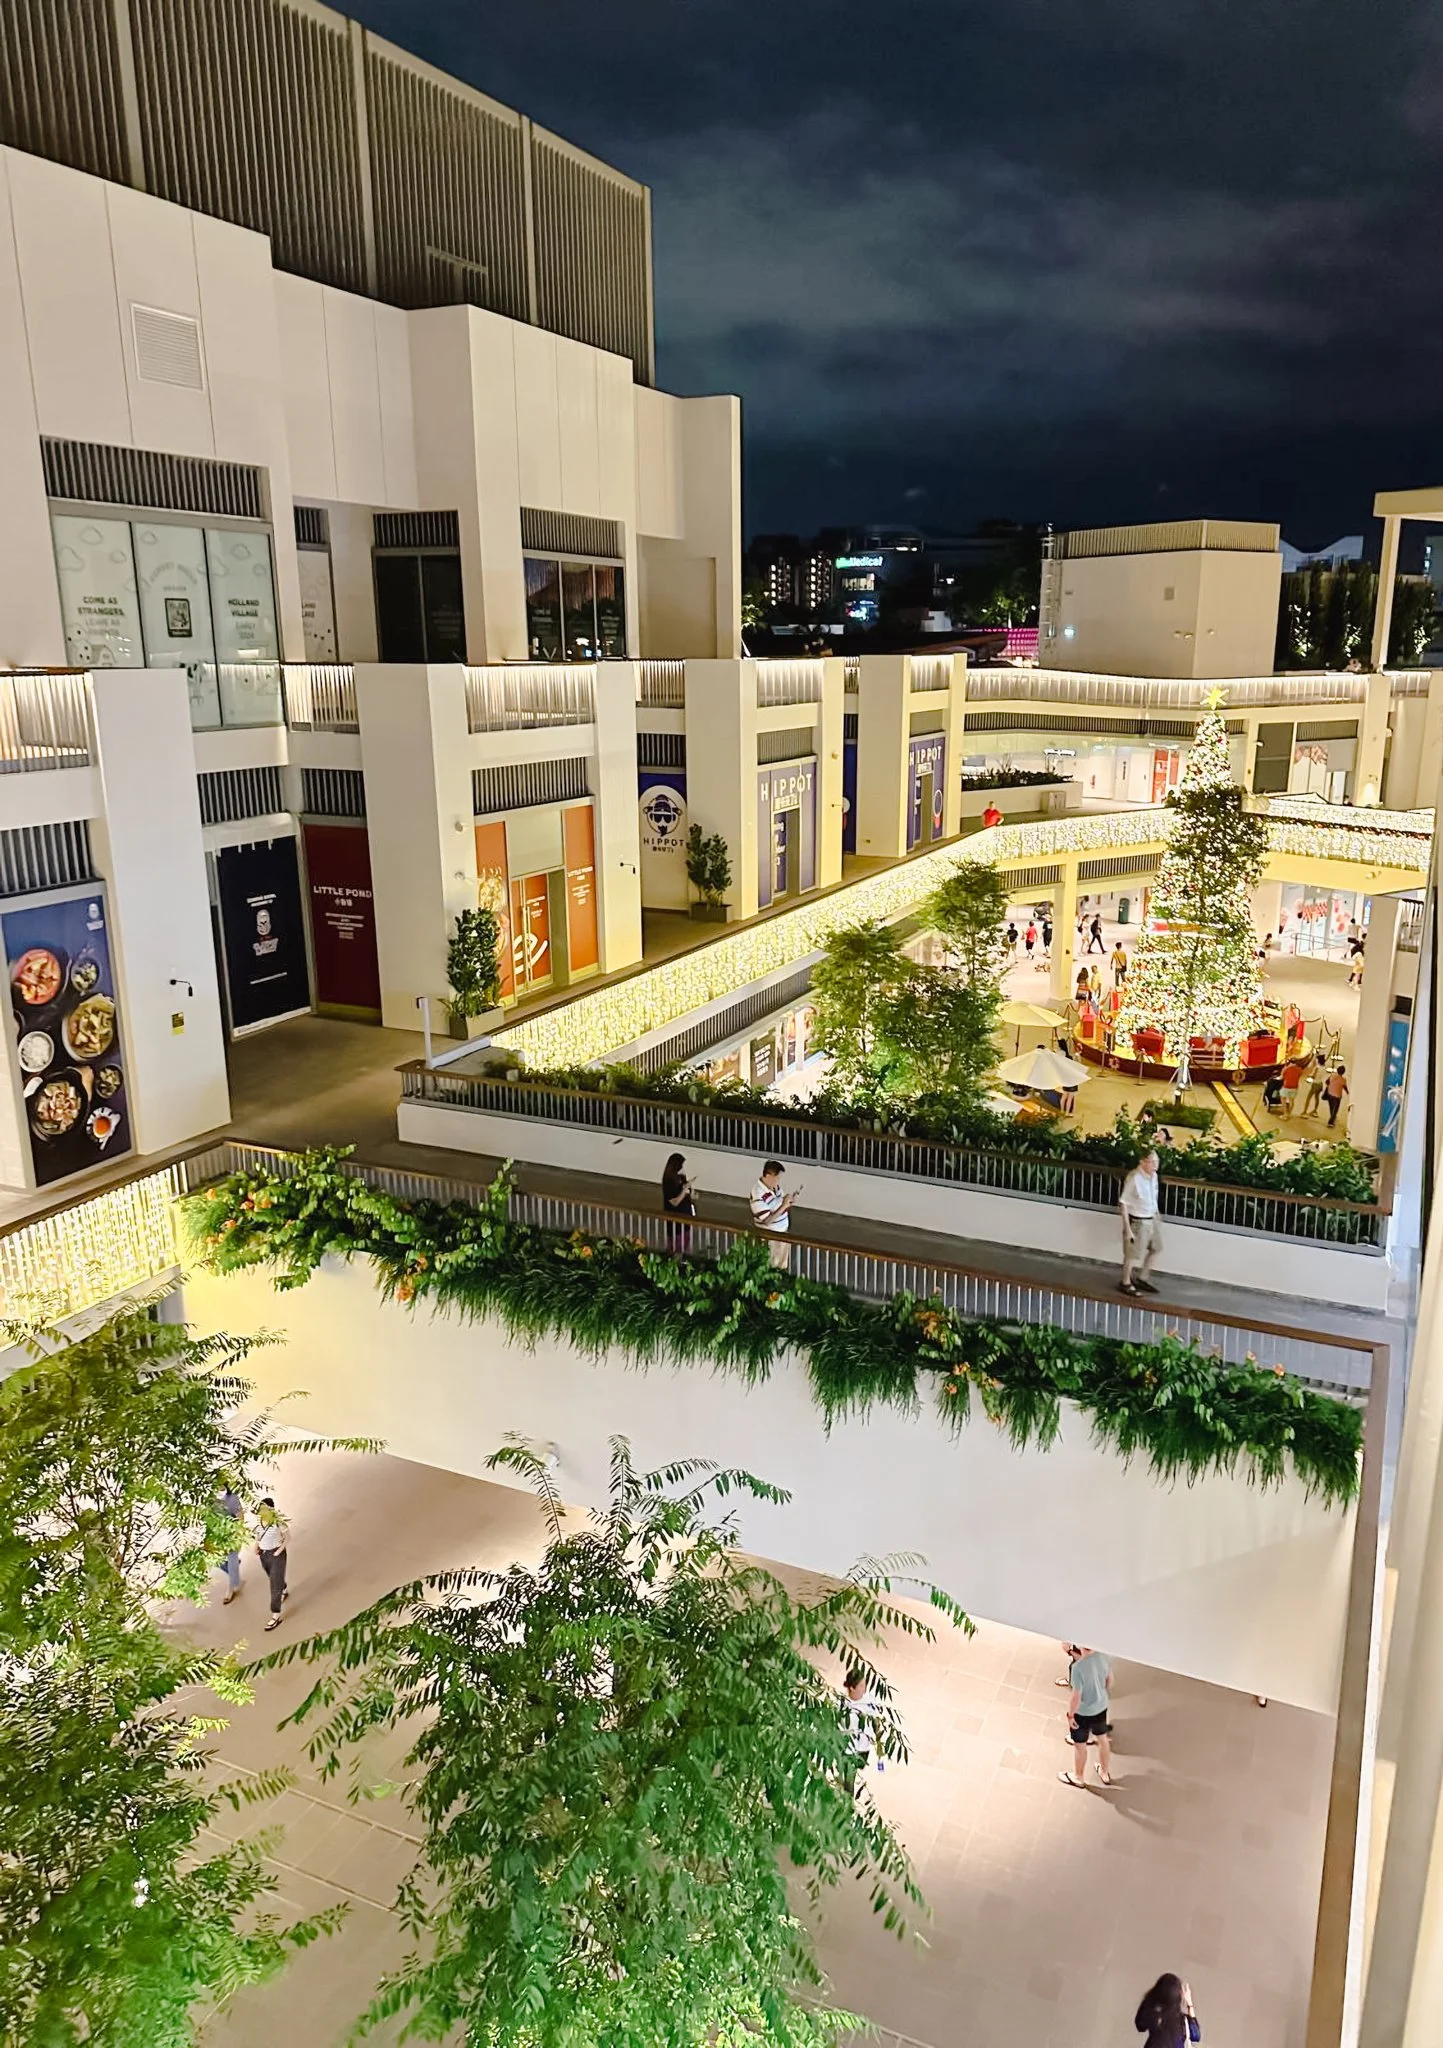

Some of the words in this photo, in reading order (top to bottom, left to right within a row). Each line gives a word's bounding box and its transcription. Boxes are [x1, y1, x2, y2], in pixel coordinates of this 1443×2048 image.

[910, 745, 942, 767] HIPPOT
[760, 773, 812, 802] HIPPOT
[643, 837, 684, 847] HIPPOT
[313, 884, 344, 897] LITTLE
[345, 888, 373, 899] POND
